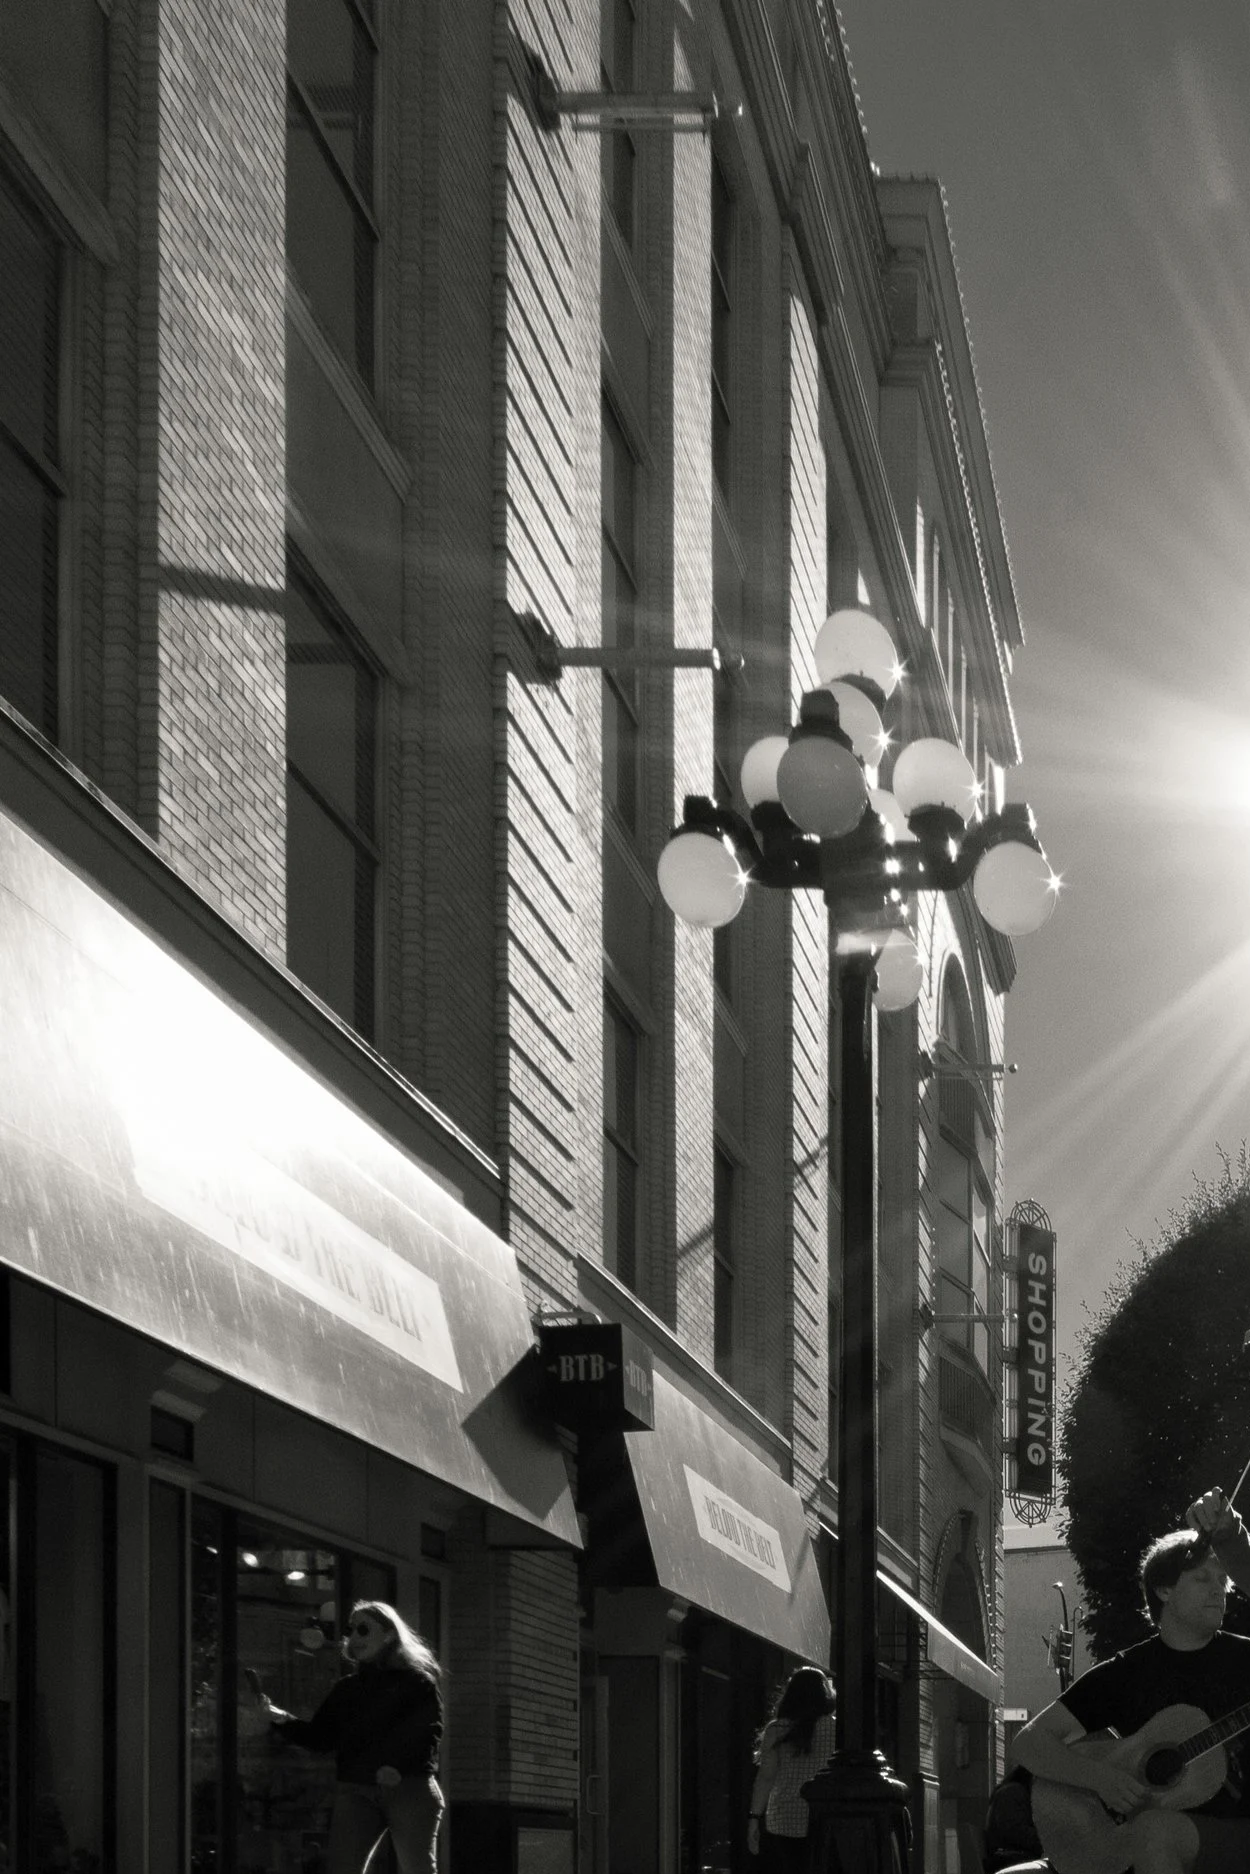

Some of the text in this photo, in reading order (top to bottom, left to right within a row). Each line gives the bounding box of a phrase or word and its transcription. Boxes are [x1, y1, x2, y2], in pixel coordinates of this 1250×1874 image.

[361, 1257, 422, 1342] BELT
[559, 1354, 604, 1382] BTB
[1027, 1252, 1047, 1466] SHOPPING
[704, 1494, 776, 1570] BELOW THE BELT
